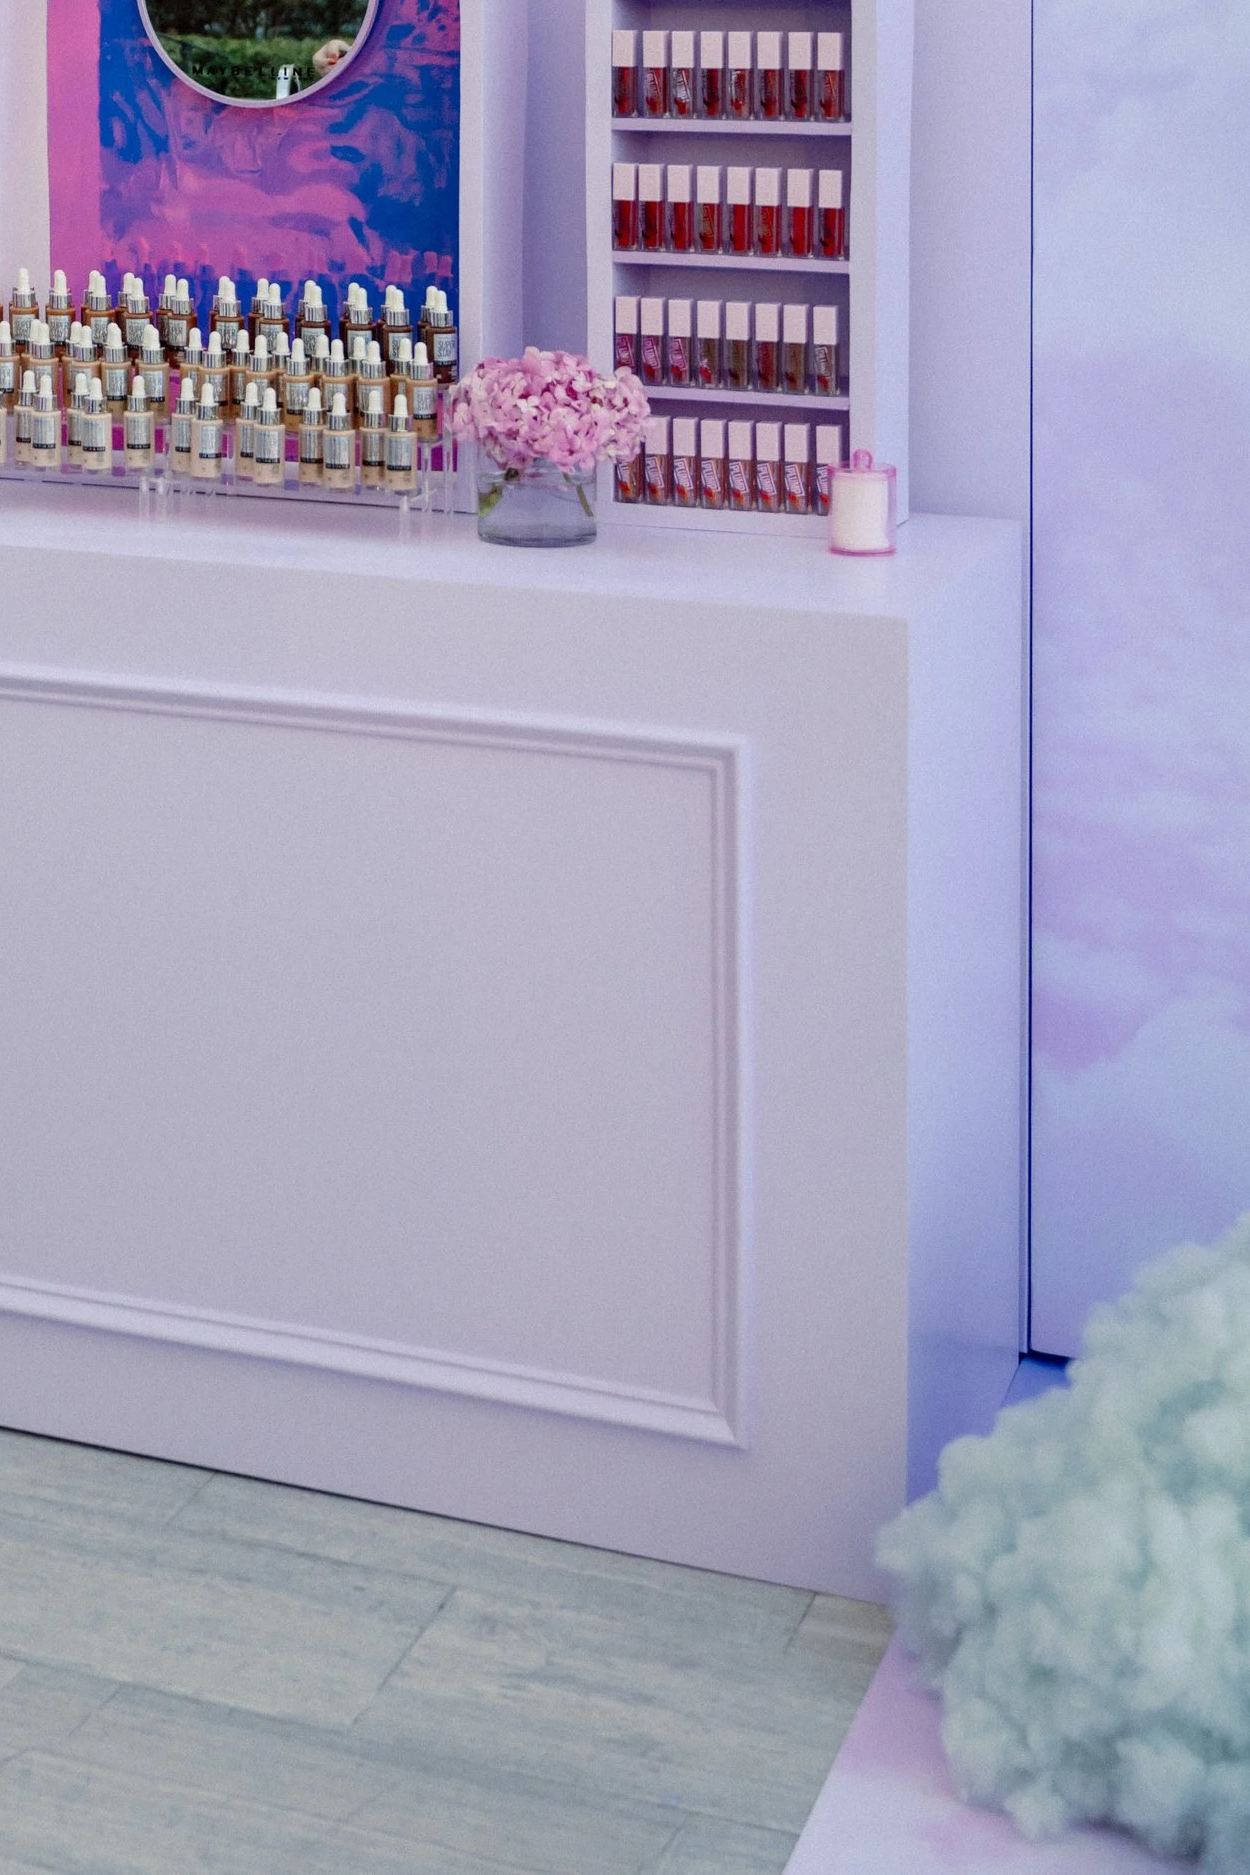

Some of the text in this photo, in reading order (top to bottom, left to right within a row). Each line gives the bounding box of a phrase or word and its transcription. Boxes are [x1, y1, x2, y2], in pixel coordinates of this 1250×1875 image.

[192, 66, 315, 77] MAYBELLINE
[674, 461, 691, 489] PLUMP
[701, 463, 718, 491] PLUMP
[730, 464, 747, 493] PLUMP
[757, 466, 775, 494] PLUMP
[785, 467, 803, 495] PLUMP
